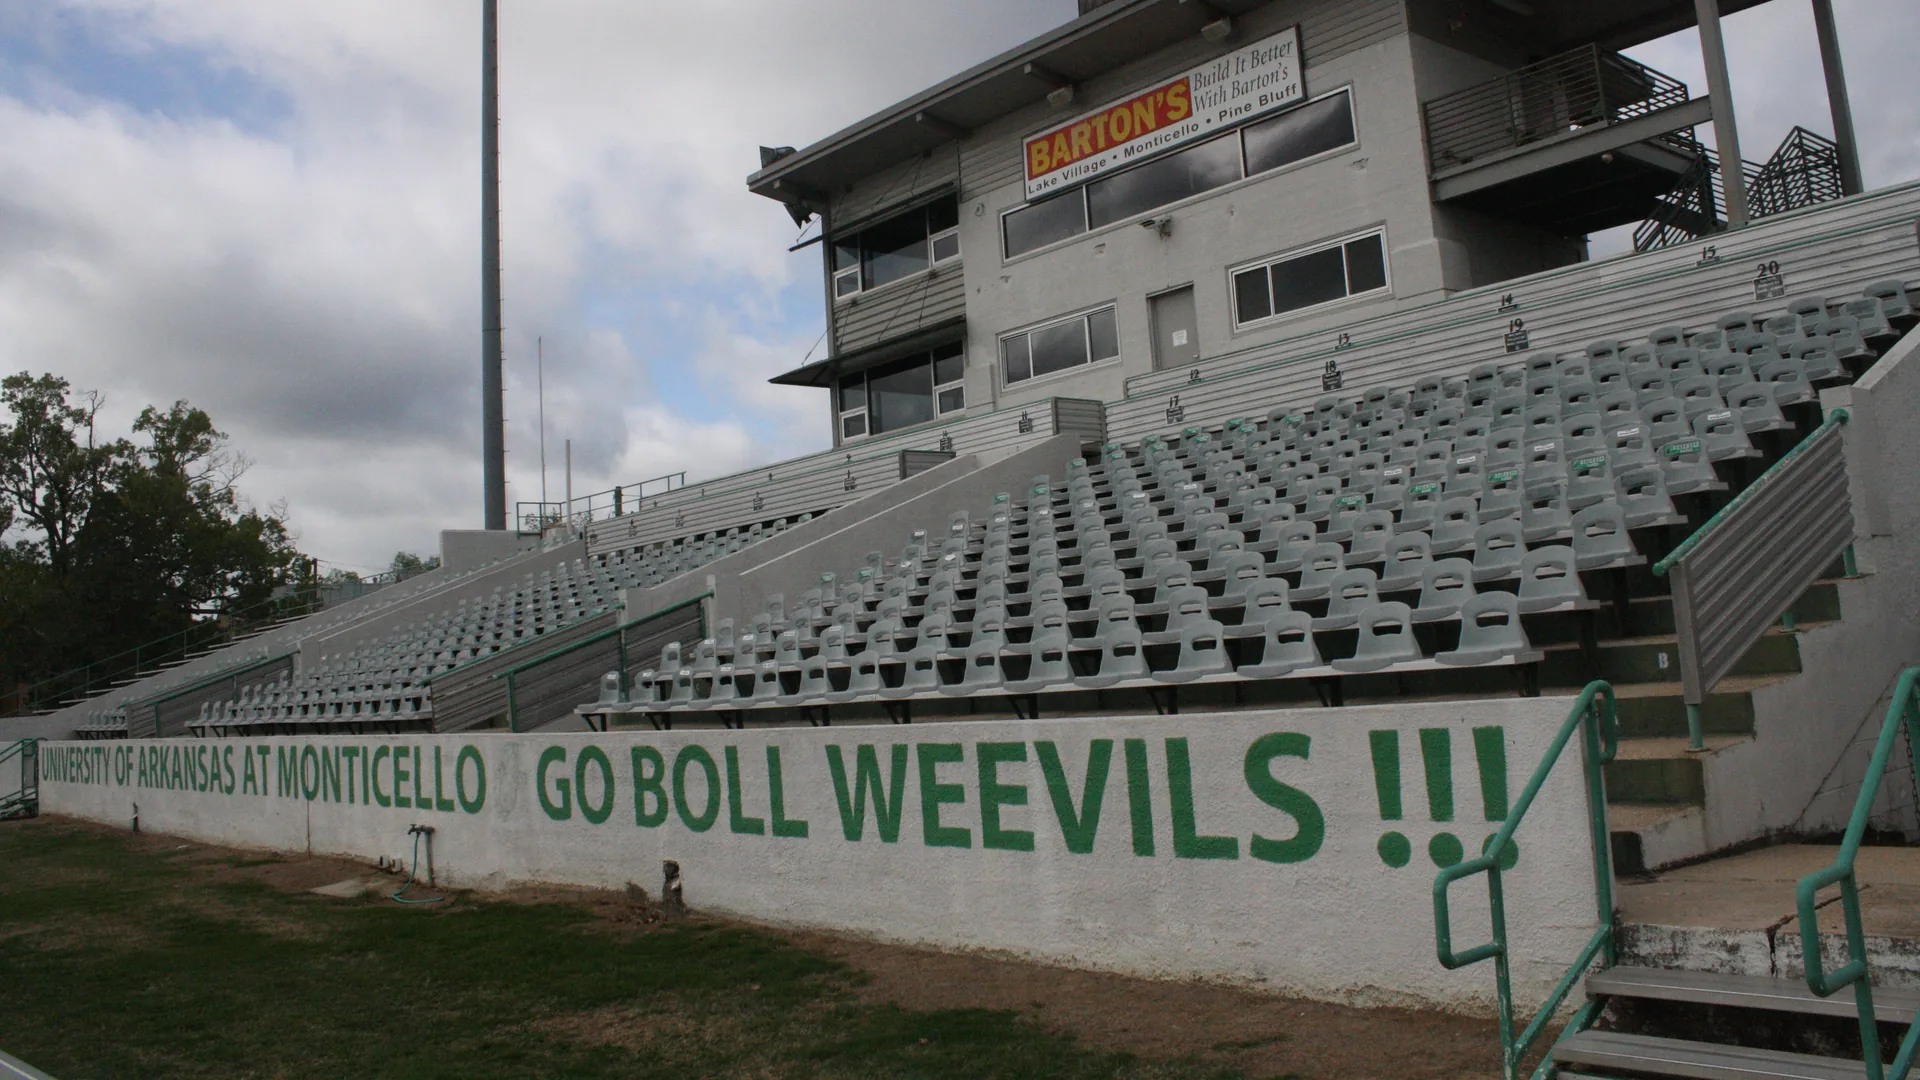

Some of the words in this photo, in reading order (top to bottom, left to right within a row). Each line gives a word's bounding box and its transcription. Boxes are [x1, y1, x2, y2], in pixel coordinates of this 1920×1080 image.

[1194, 61, 1230, 92] Build
[1235, 56, 1246, 76] It
[1250, 41, 1293, 70] Better
[1194, 84, 1226, 112] With
[1231, 63, 1288, 100] Barton's
[1028, 176, 1058, 194] Lake
[1062, 158, 1106, 181] Village
[1124, 122, 1199, 159] Monticello
[1219, 102, 1252, 122] Pine
[1258, 83, 1297, 107] Bluff
[1029, 83, 1189, 177] BARTON'S
[1702, 245, 1716, 260] 15
[1757, 260, 1780, 278] 20
[1509, 318, 1524, 333] 19
[1325, 360, 1337, 373] 18
[1169, 395, 1179, 408] 17
[41, 746, 110, 785] UNIVERSITY
[114, 745, 134, 786] OF
[138, 745, 236, 796] ARKANSAS
[243, 745, 271, 797] AT
[278, 744, 487, 815] MONTICELLO
[536, 745, 615, 826] GO
[630, 744, 810, 840] BOLL
[825, 731, 1326, 864] WEEVILS
[1368, 725, 1519, 871] !!!
